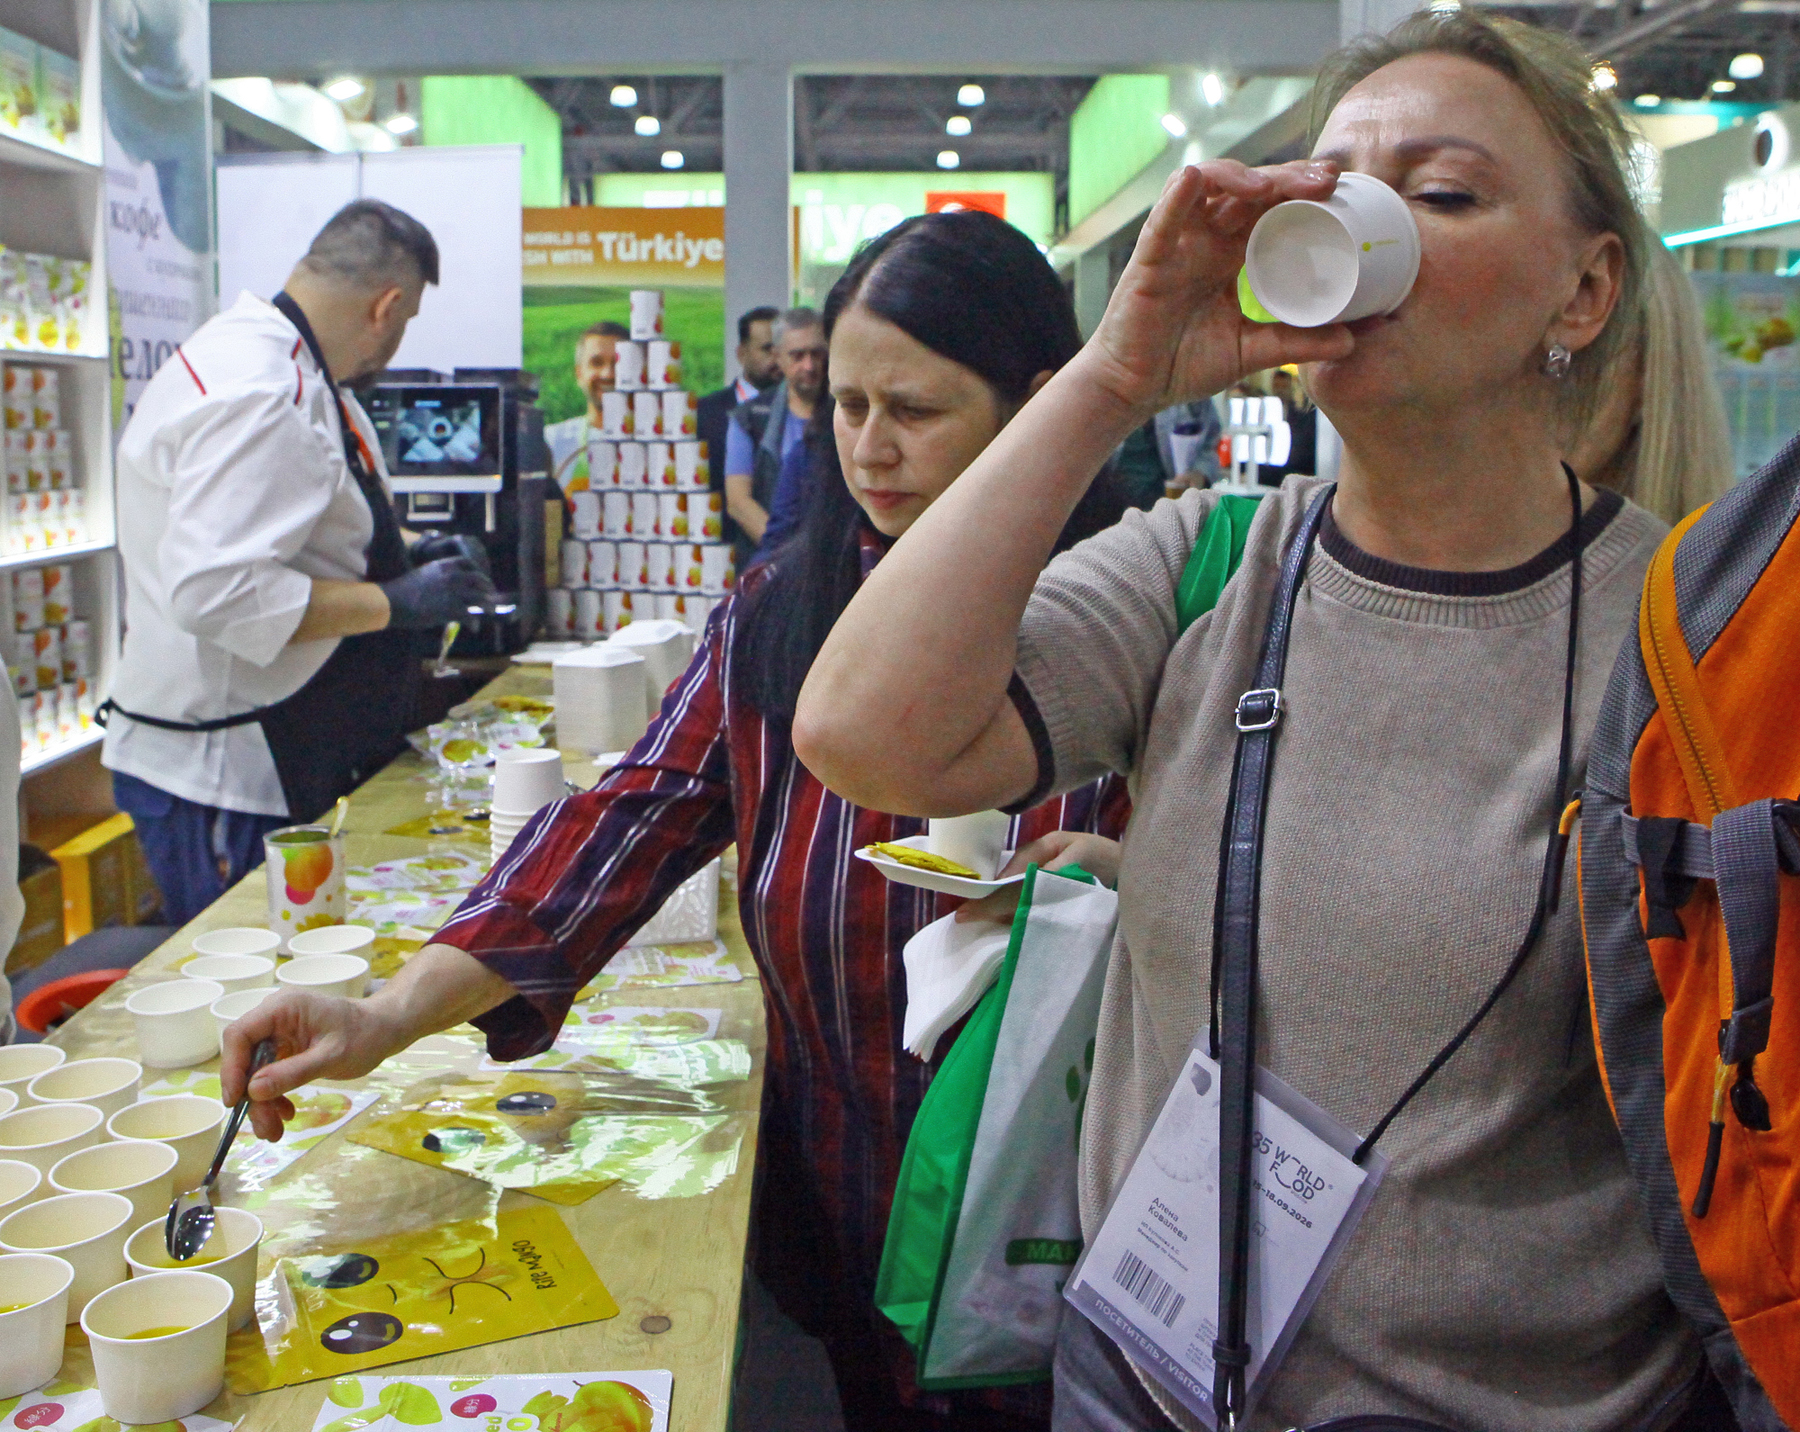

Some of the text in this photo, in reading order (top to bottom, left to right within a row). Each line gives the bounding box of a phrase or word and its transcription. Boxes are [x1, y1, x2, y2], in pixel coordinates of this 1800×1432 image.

[110, 197, 160, 250] кофе
[805, 189, 905, 262] iye
[597, 231, 724, 268] Türkiye
[109, 335, 181, 381] ело
[1148, 1205, 1188, 1241] Ковалева
[1152, 1197, 1179, 1222] Алена
[1095, 1299, 1208, 1401] ПОСЕТИТЕЛЬ / VISITOR
